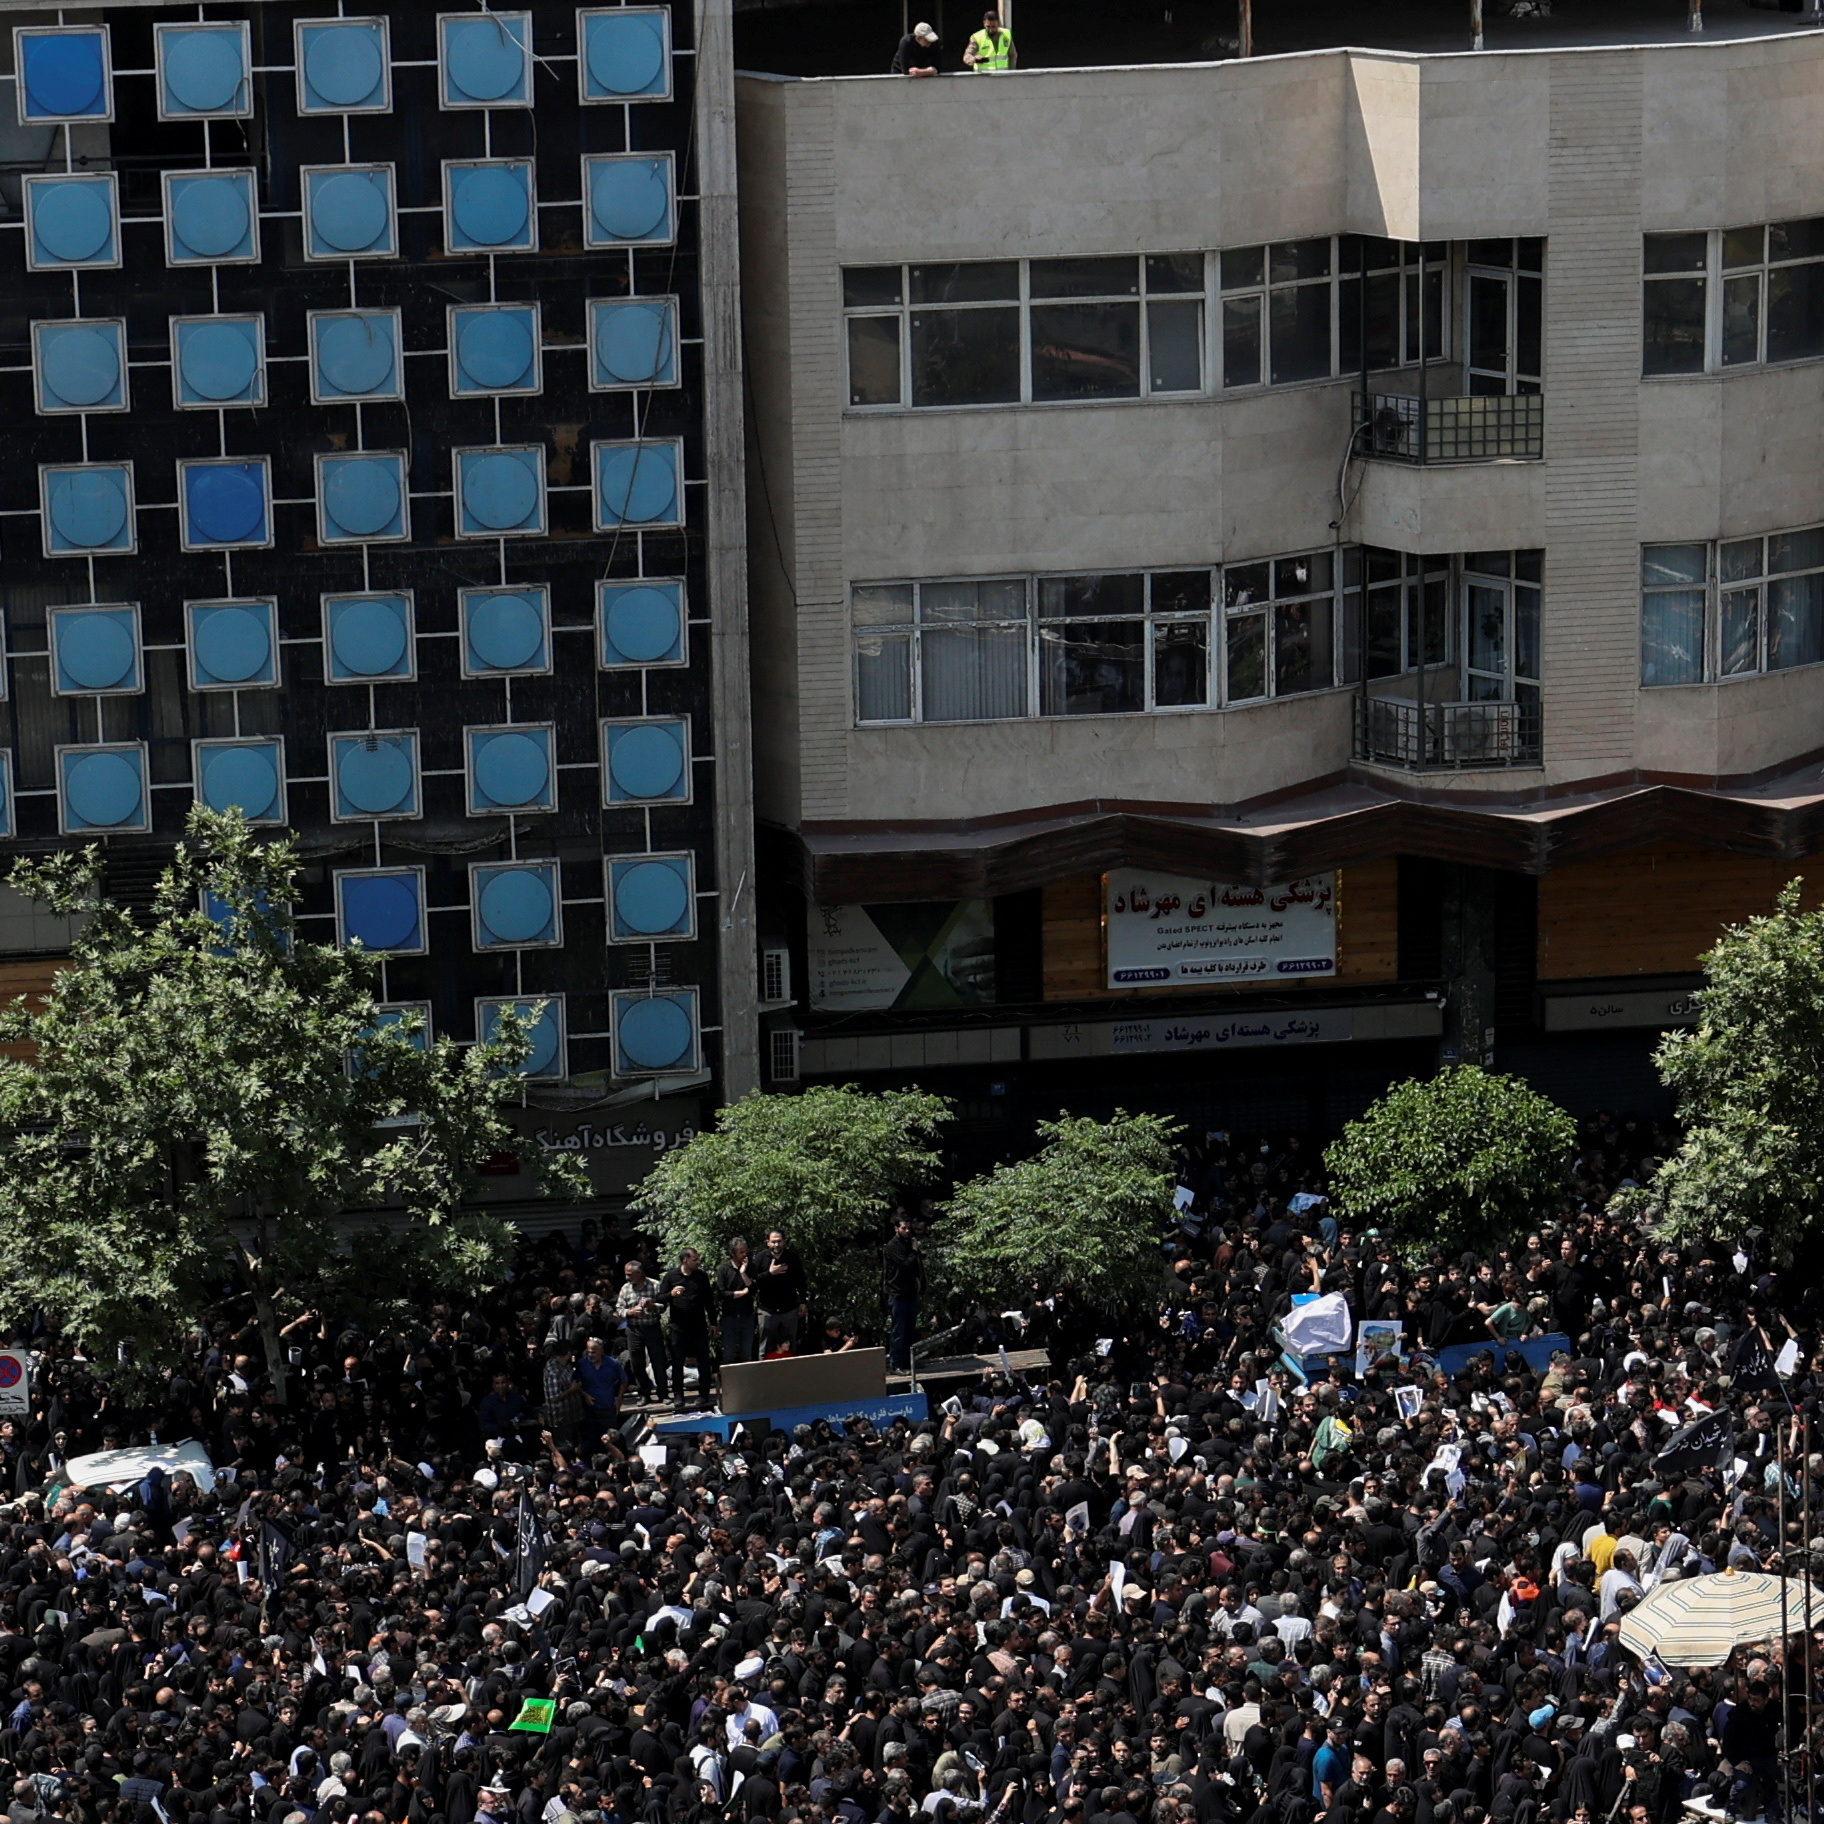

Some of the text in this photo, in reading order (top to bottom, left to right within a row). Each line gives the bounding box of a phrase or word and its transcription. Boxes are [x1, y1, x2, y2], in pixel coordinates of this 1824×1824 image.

[1114, 889, 1181, 919] مهرشاد
[1157, 926, 1183, 935] Gated
[1185, 924, 1214, 934] SPECT
[1597, 1005, 1624, 1017] سالن
[1164, 1019, 1320, 1045] پزشکی هسته ای مهرشاد
[593, 1119, 695, 1151] فروشگاه
